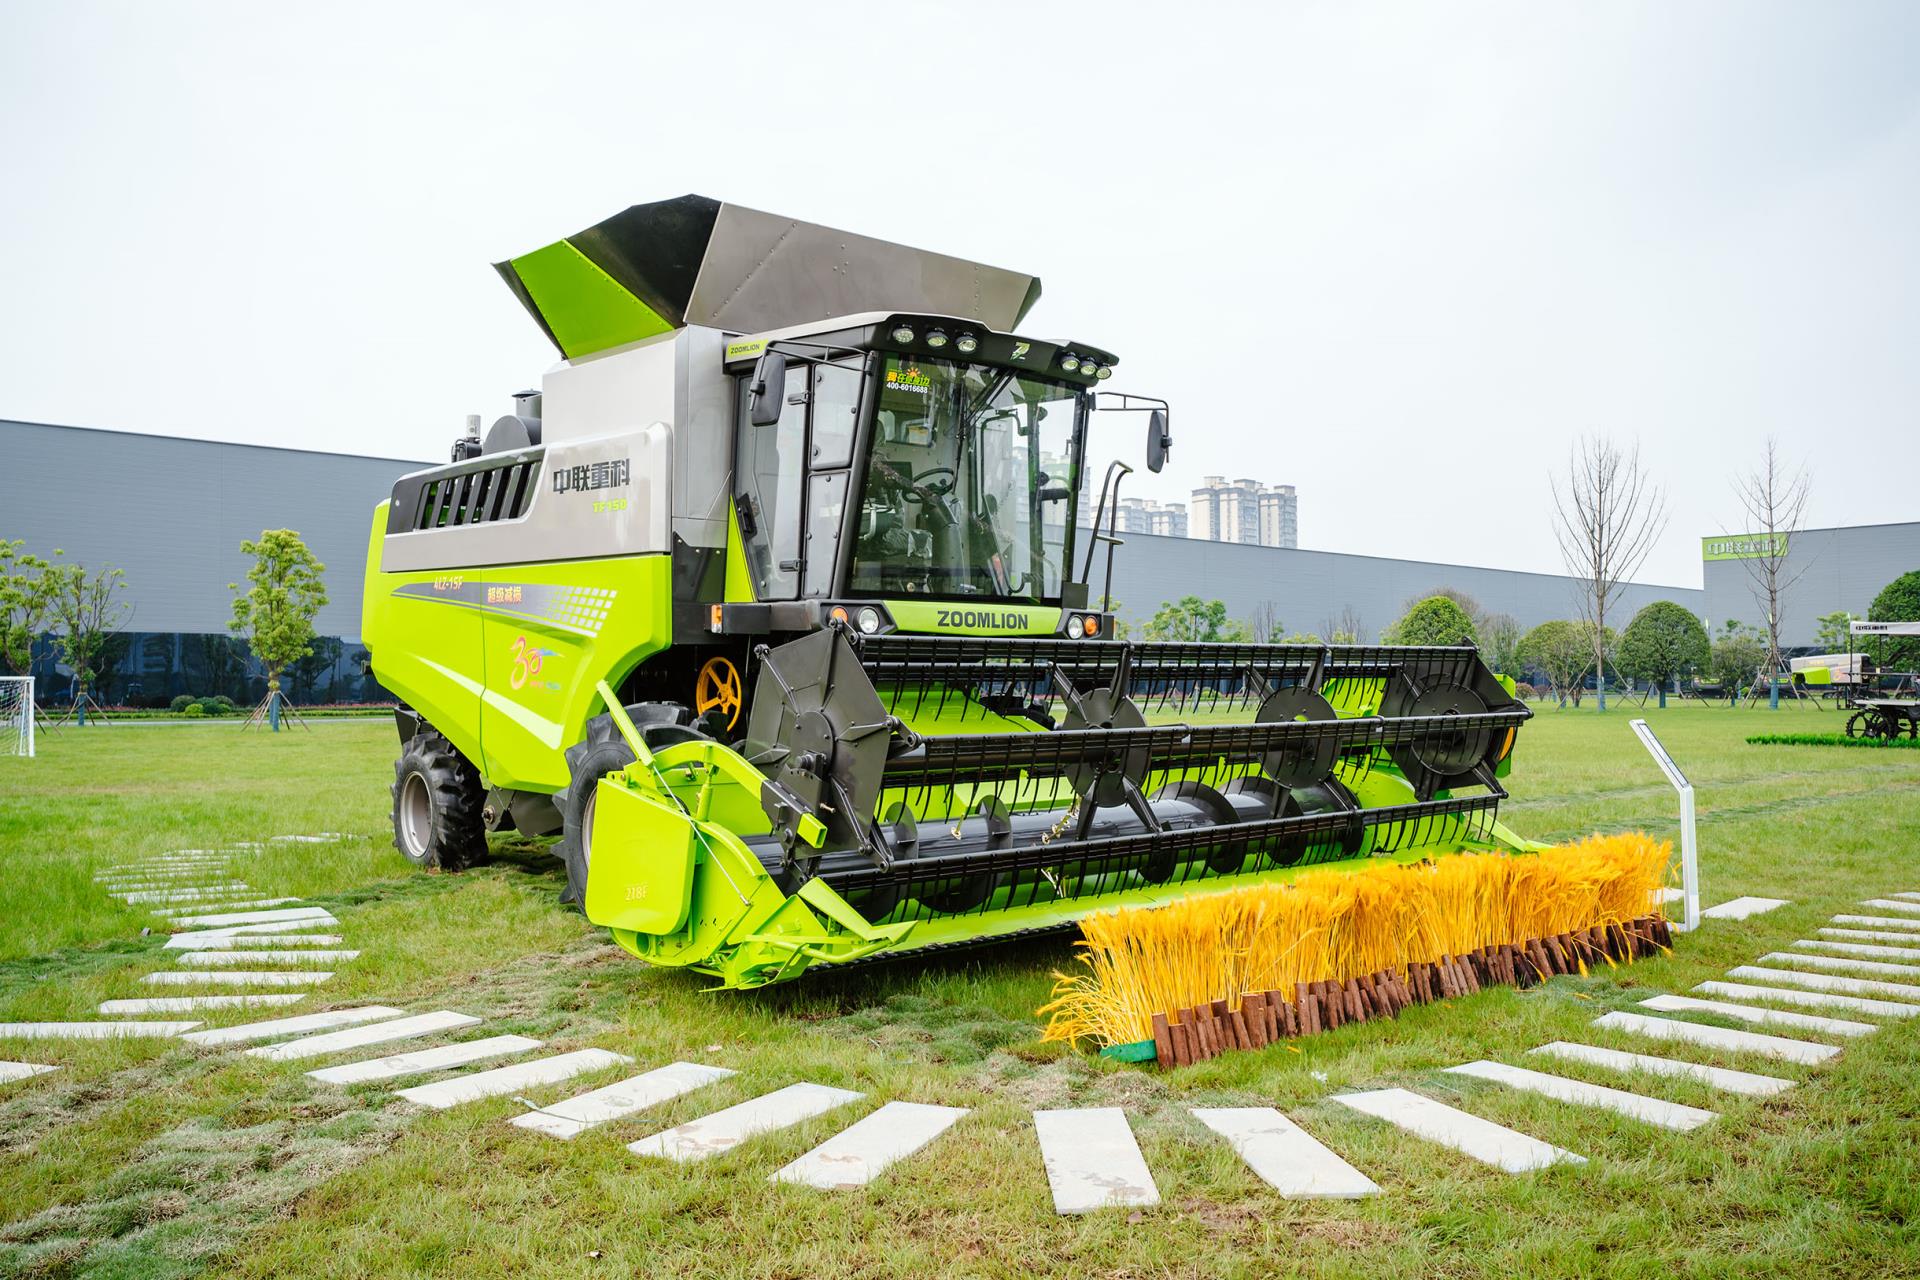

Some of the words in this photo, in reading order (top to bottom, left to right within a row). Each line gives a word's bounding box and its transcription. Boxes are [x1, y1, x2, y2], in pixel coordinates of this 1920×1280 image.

[730, 343, 760, 354] ZOOMLION
[553, 458, 630, 494] 中联重科
[937, 610, 1028, 630] ZOOMLION
